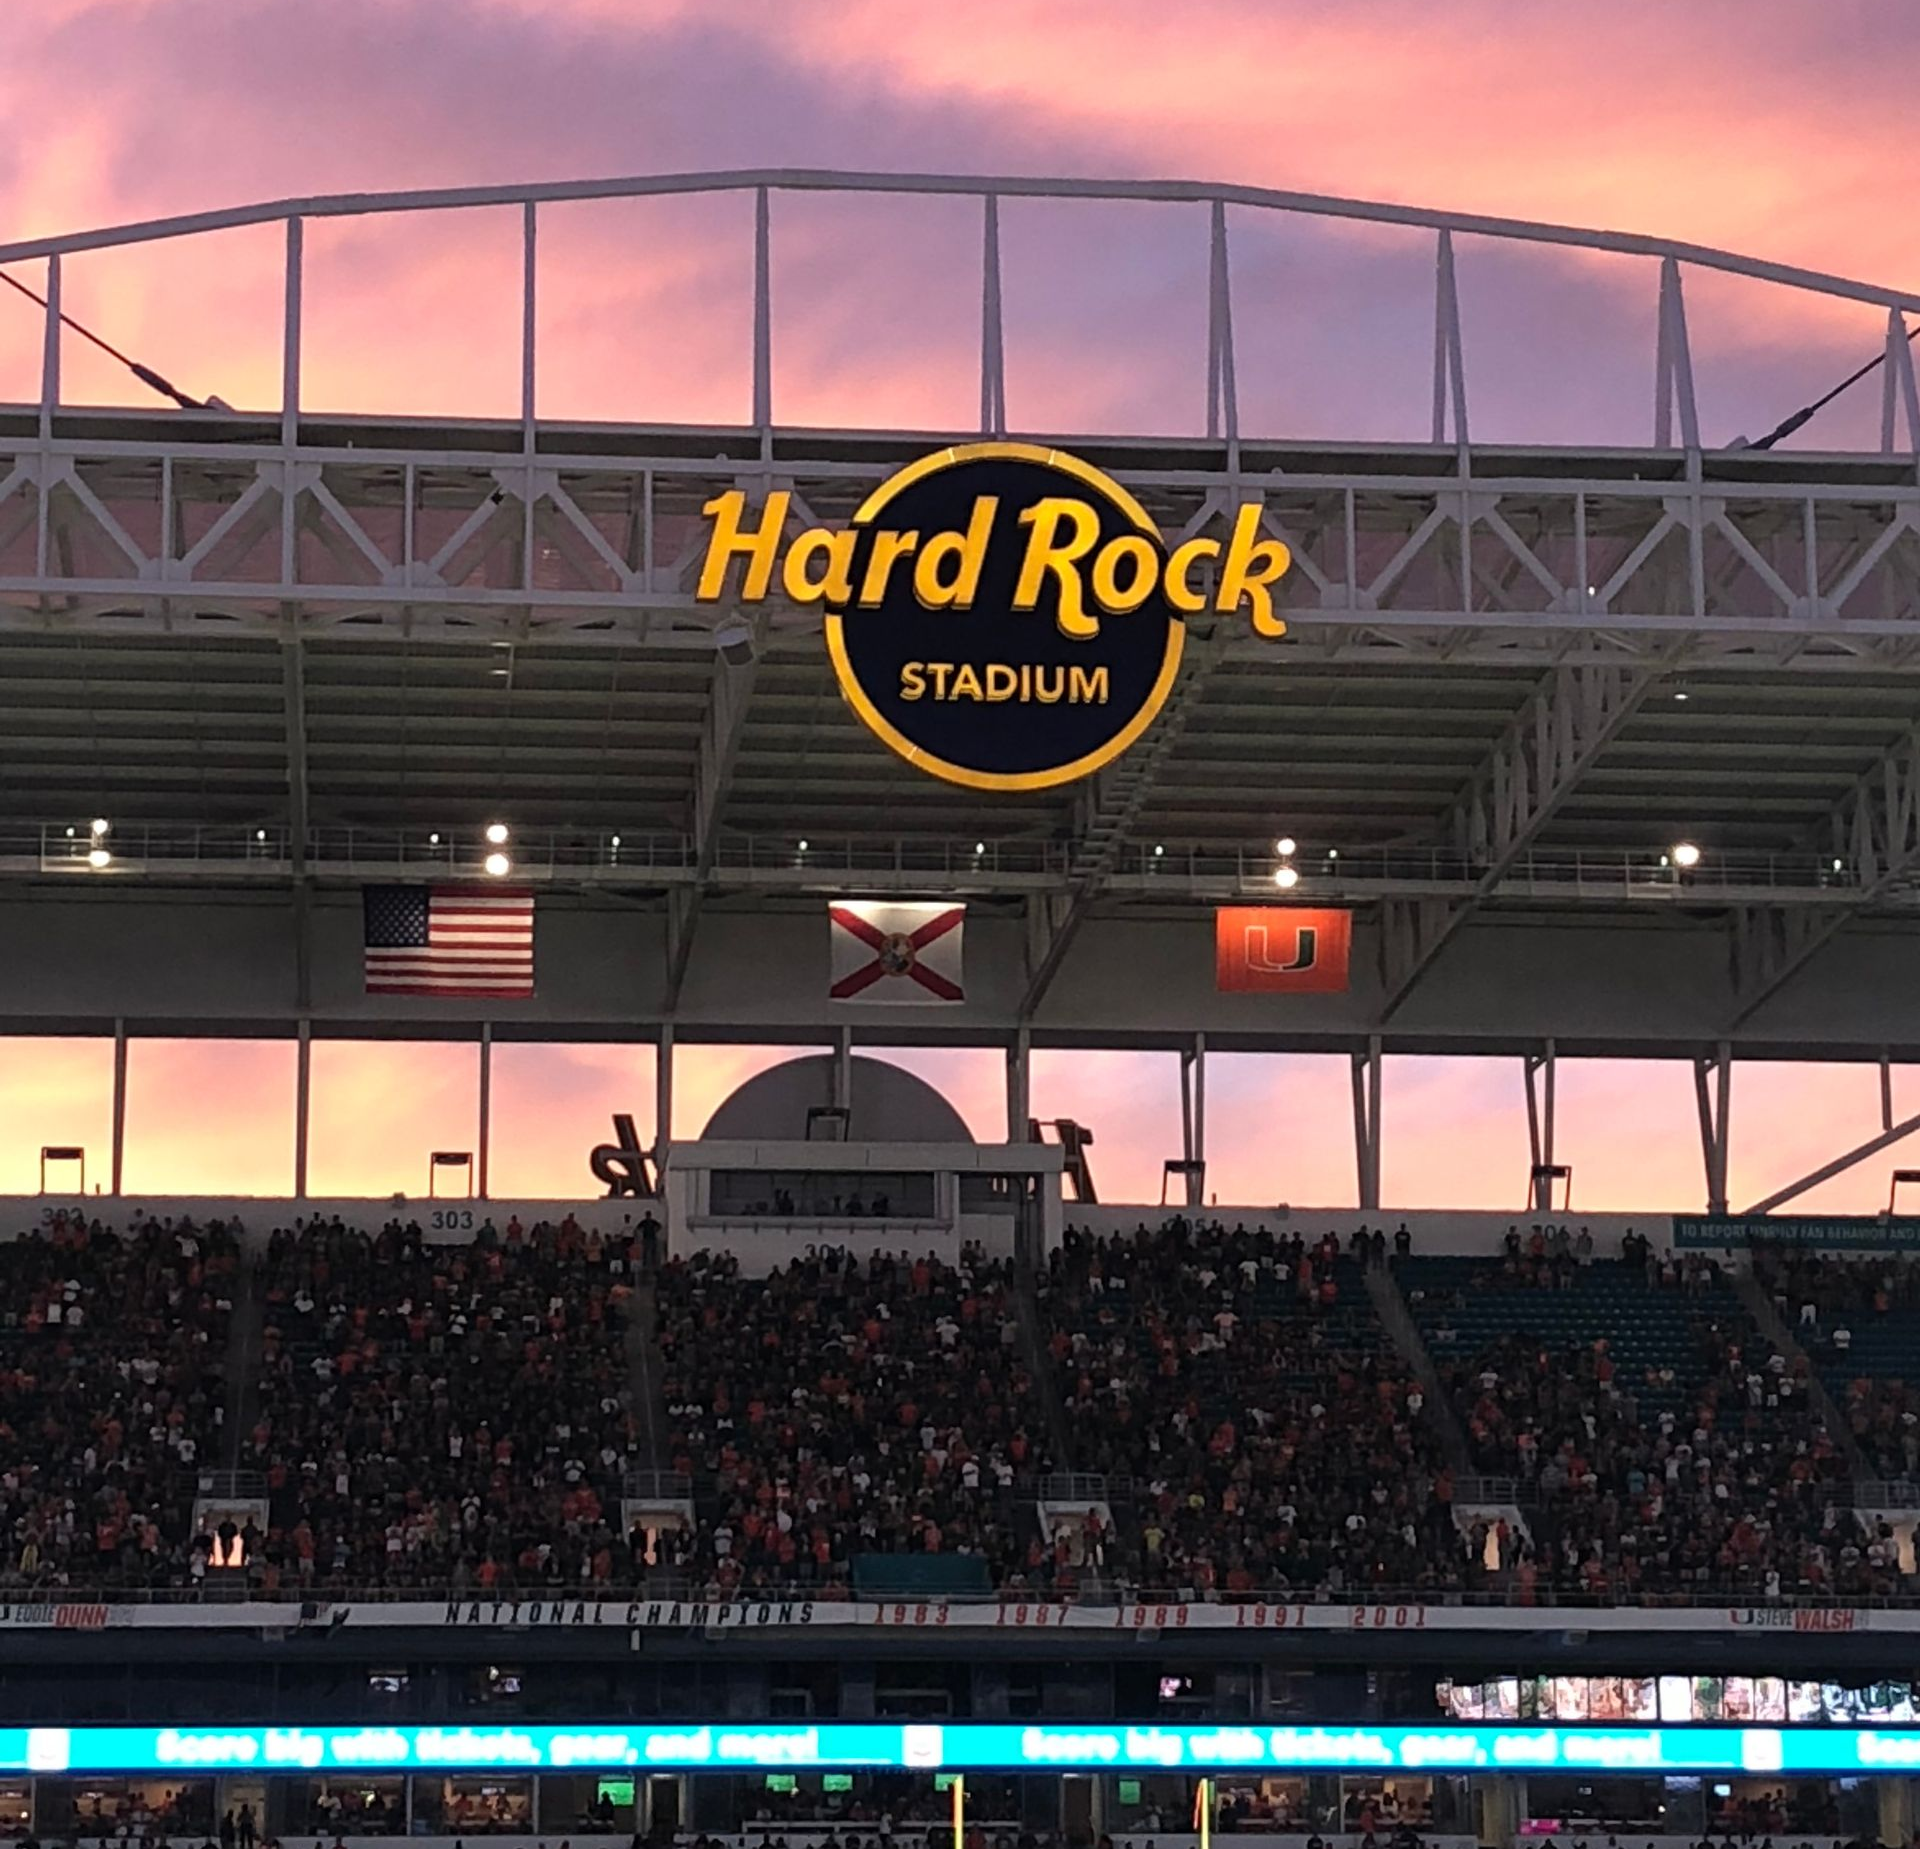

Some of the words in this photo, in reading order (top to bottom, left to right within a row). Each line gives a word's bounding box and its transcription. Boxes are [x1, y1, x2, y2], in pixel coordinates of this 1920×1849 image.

[697, 489, 1001, 612] Hard
[1010, 497, 1292, 641] Rock
[899, 660, 1110, 705] STADIUM
[431, 1210, 474, 1230] 303
[1682, 1223, 1697, 1238] TO
[1700, 1223, 1747, 1239] REPORT
[1800, 1224, 1825, 1239] FAN
[15, 1604, 56, 1623] EDDIE
[55, 1604, 109, 1627] DUNN
[445, 1602, 604, 1624] NATIONAL
[625, 1602, 814, 1625] CHAMPIONS
[873, 1604, 949, 1627] 1983
[996, 1604, 1069, 1627] 1987
[1114, 1604, 1189, 1627] 1989
[1235, 1604, 1304, 1627] 1991
[1353, 1605, 1426, 1628] 2001
[1757, 1609, 1793, 1626] STEVE
[1794, 1608, 1855, 1630] WALSH
